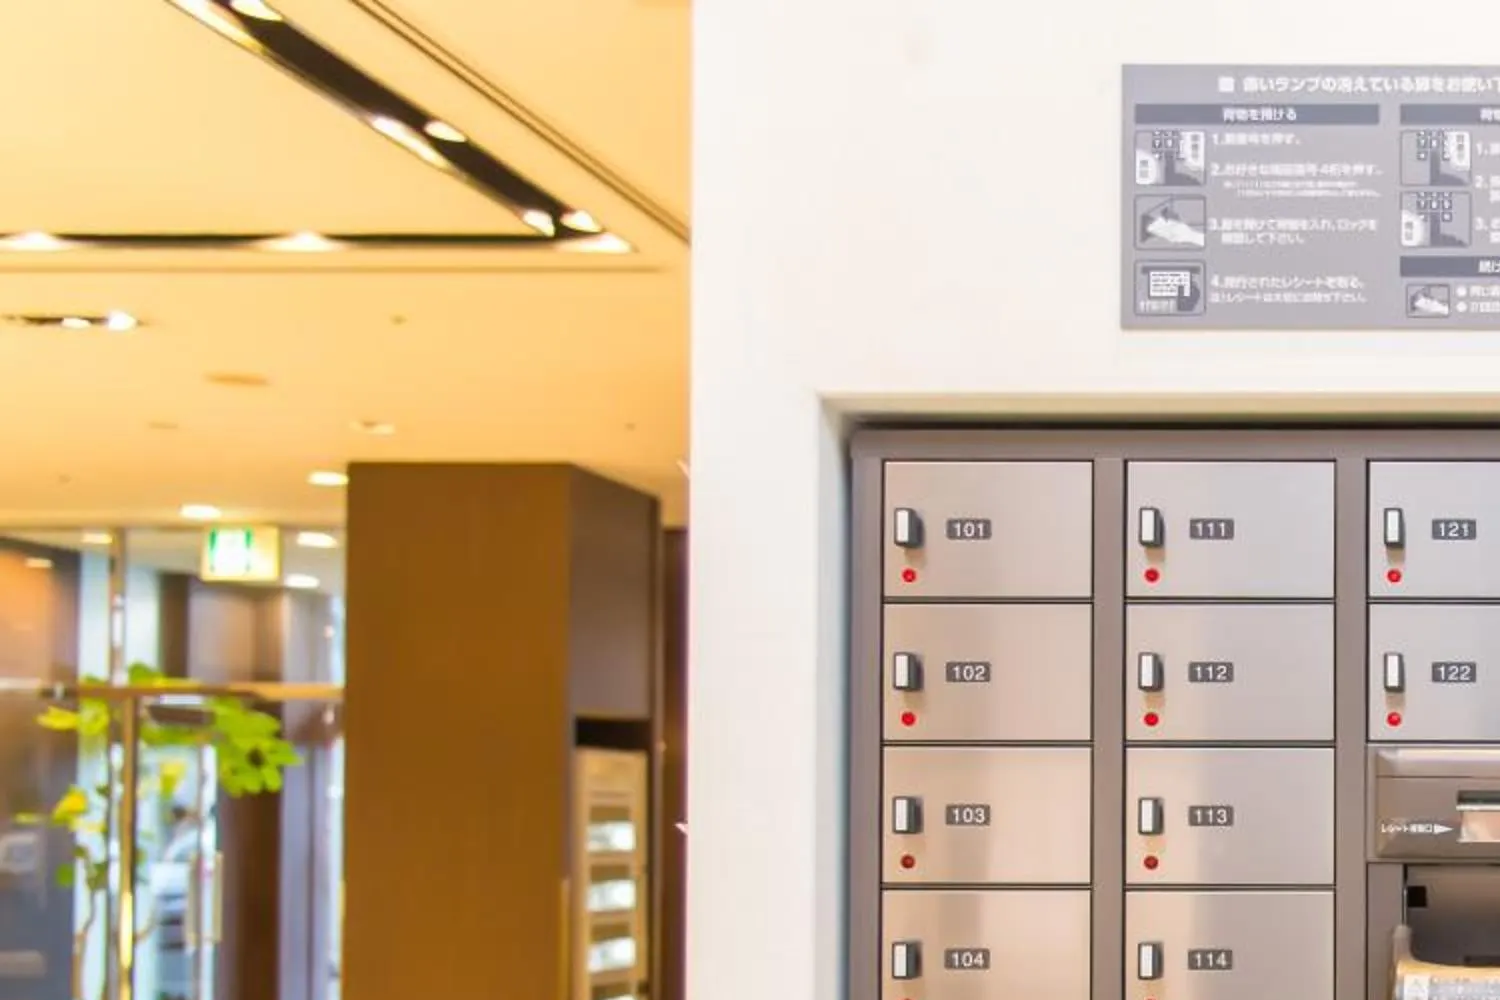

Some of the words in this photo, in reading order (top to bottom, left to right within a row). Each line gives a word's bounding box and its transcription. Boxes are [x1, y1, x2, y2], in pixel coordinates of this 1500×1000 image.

[954, 521, 984, 537] 101
[1195, 522, 1225, 537] 111
[1439, 521, 1469, 537] 121
[953, 665, 986, 681] 102
[1195, 665, 1227, 681] 112
[1438, 665, 1471, 681] 122
[953, 807, 985, 823] 103
[1195, 808, 1227, 824] 113
[952, 951, 984, 967] 104
[1195, 952, 1227, 967] 114
